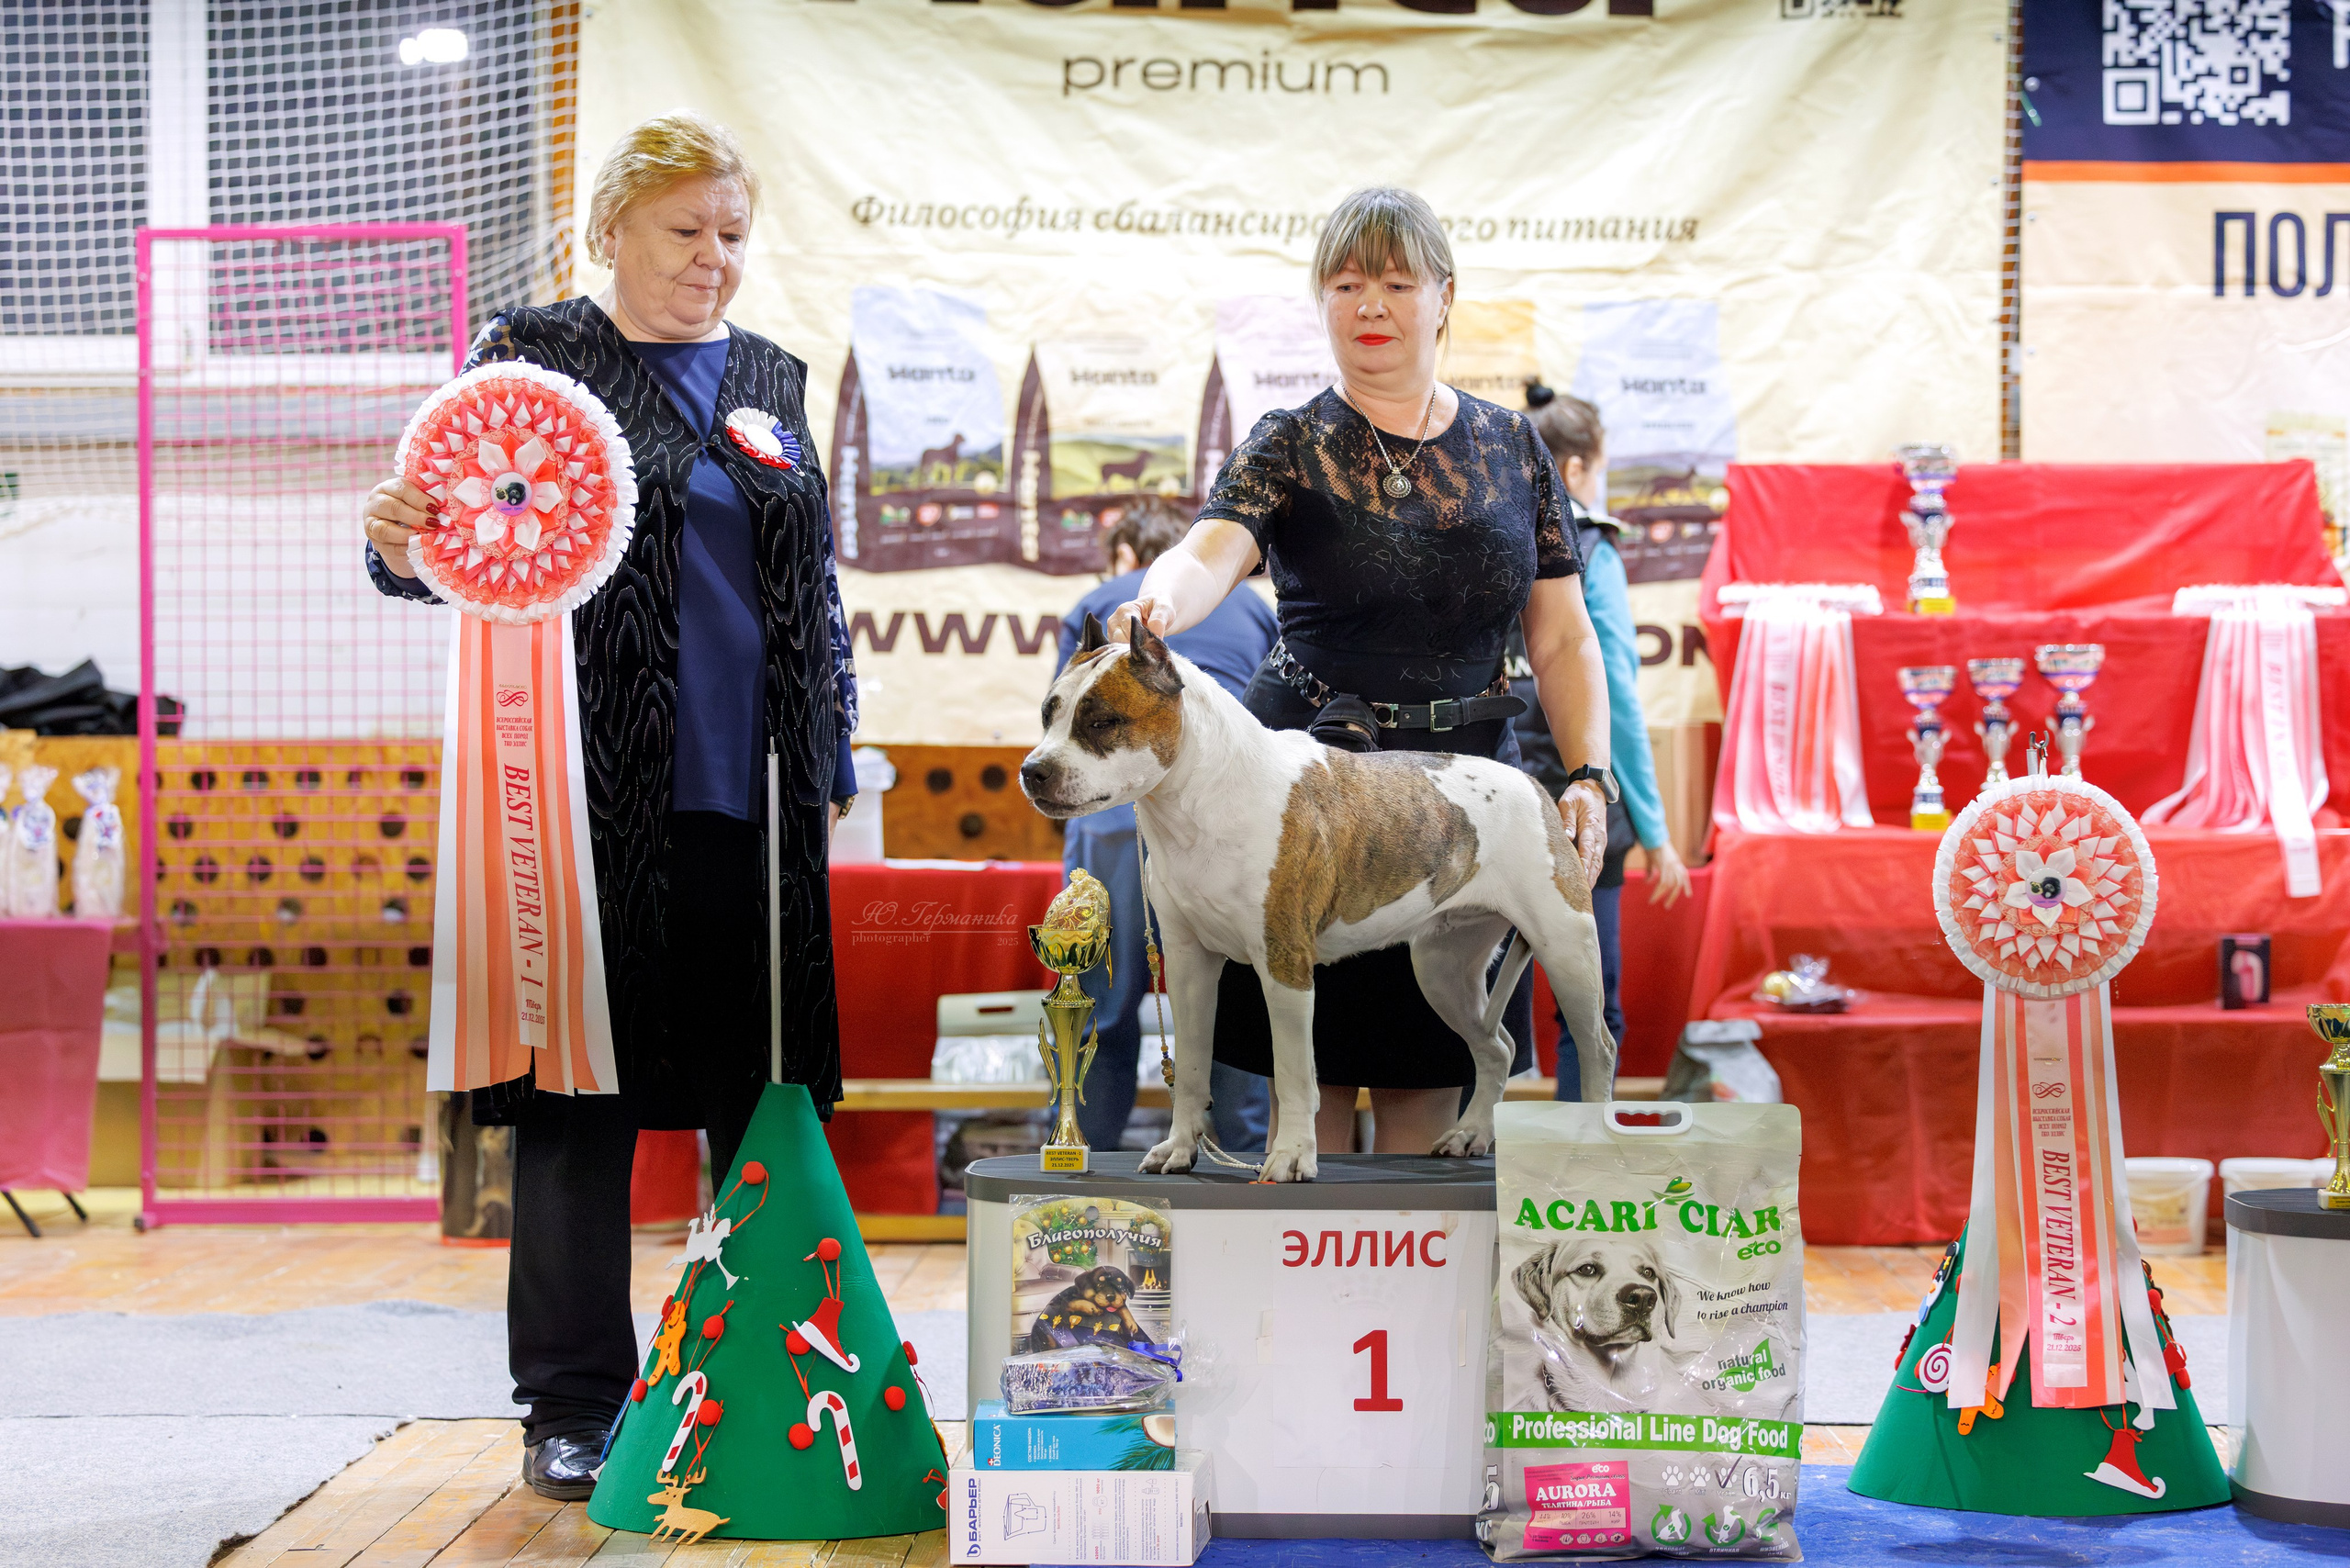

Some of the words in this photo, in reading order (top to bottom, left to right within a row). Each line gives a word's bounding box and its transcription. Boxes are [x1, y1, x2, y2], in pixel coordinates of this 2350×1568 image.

[1062, 49, 1389, 96] premium
[851, 195, 1084, 240] Философия
[1506, 213, 1699, 242] питания
[504, 763, 533, 831] BEST
[509, 836, 543, 957] VETERAN
[2042, 1148, 2072, 1201] BEST
[1514, 1197, 1659, 1233] ACARI
[1678, 1200, 1785, 1239] CIAR
[1027, 1227, 1163, 1249] Благополучия
[1282, 1230, 1447, 1268] ЭЛЛИС
[1737, 1240, 1782, 1260] eco
[2045, 1205, 2076, 1300] VETERAN
[1696, 1291, 1715, 1302] We
[1717, 1288, 1746, 1301] know
[1748, 1282, 1771, 1293] how
[1709, 1310, 1729, 1320] rise
[1731, 1307, 1739, 1316] a
[1740, 1300, 1788, 1315] champion
[1718, 1349, 1768, 1371] natural
[2047, 1344, 2081, 1352] 21.12.2025
[1353, 1329, 1404, 1412] 1
[1702, 1370, 1756, 1391] organic
[1757, 1362, 1786, 1381] food
[993, 1424, 1002, 1467] DEONICA
[1513, 1414, 1643, 1442] Professional
[1650, 1417, 1696, 1442] Line
[1702, 1418, 1742, 1450] Dog
[1747, 1421, 1788, 1449] Food
[1592, 1463, 1610, 1473] eco
[1742, 1466, 1780, 1503] 6,5
[968, 1478, 978, 1542] БАРЬЕР
[1535, 1483, 1617, 1501] AURORA
[1541, 1499, 1612, 1508] ТЕЛЯТИНА/РЫБА
[1582, 1511, 1596, 1519] 26%
[1608, 1510, 1621, 1518] 14%
